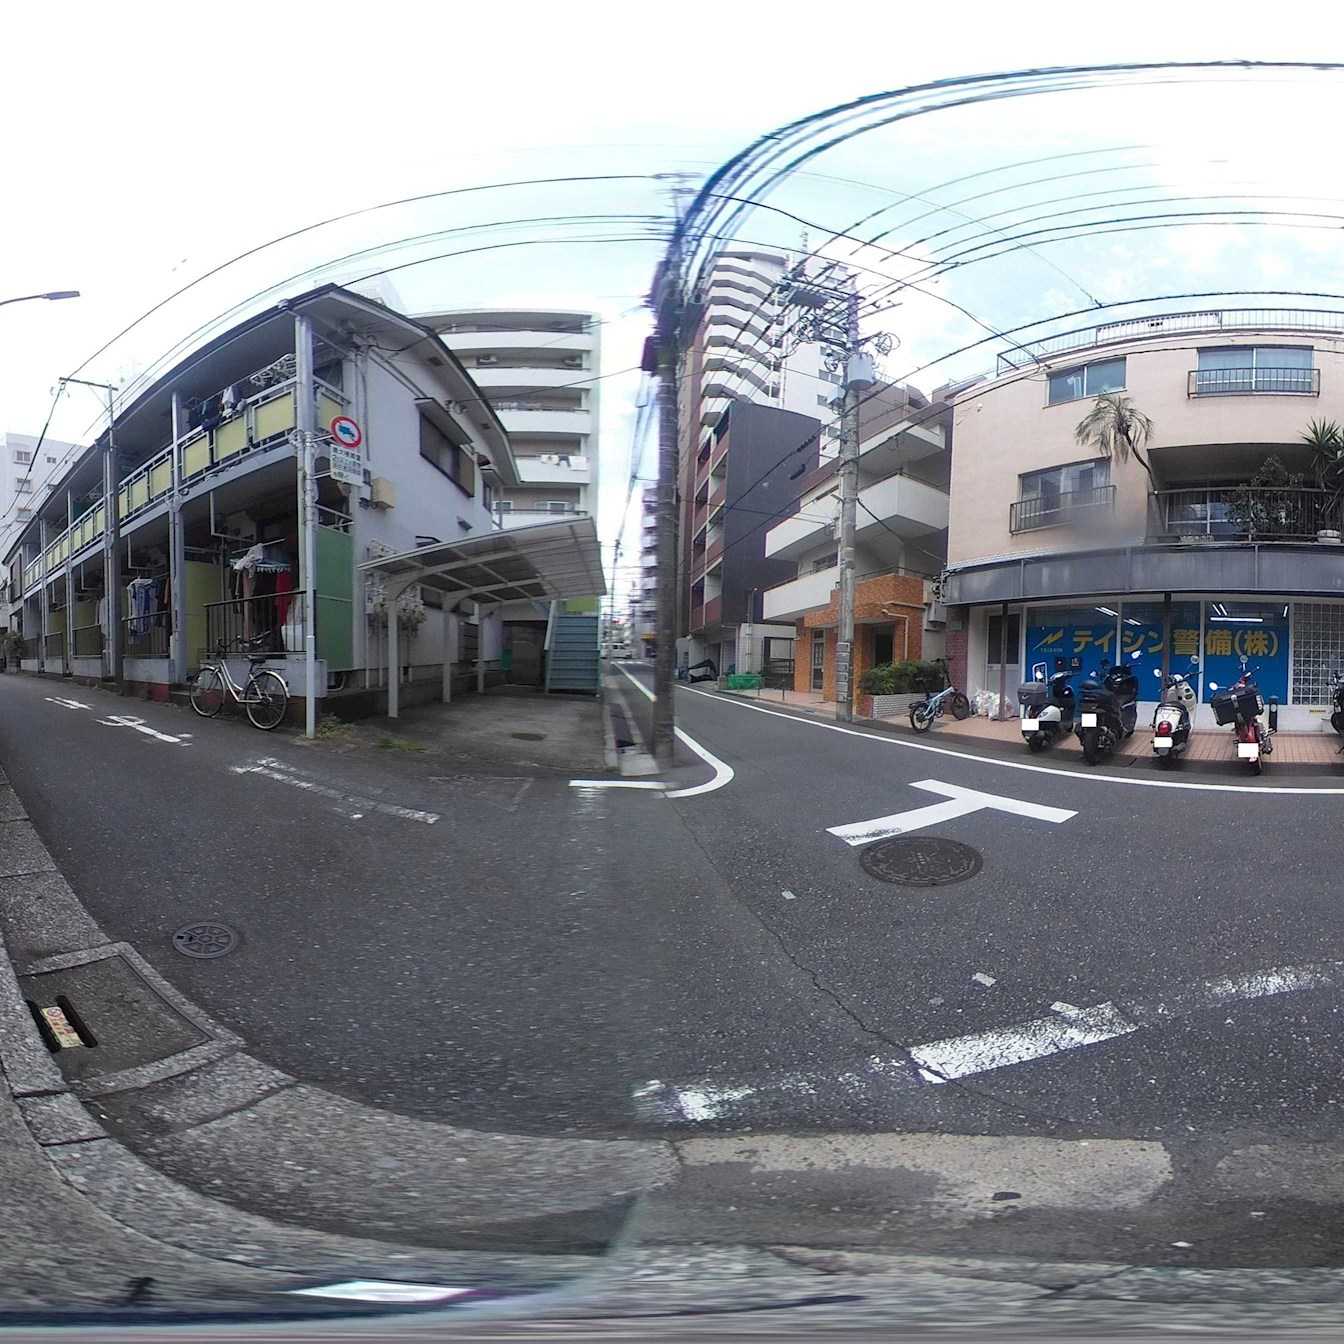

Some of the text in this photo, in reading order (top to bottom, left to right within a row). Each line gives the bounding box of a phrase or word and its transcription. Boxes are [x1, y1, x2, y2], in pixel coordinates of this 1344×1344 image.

[1072, 629, 1279, 657] テイシン警備(株)
